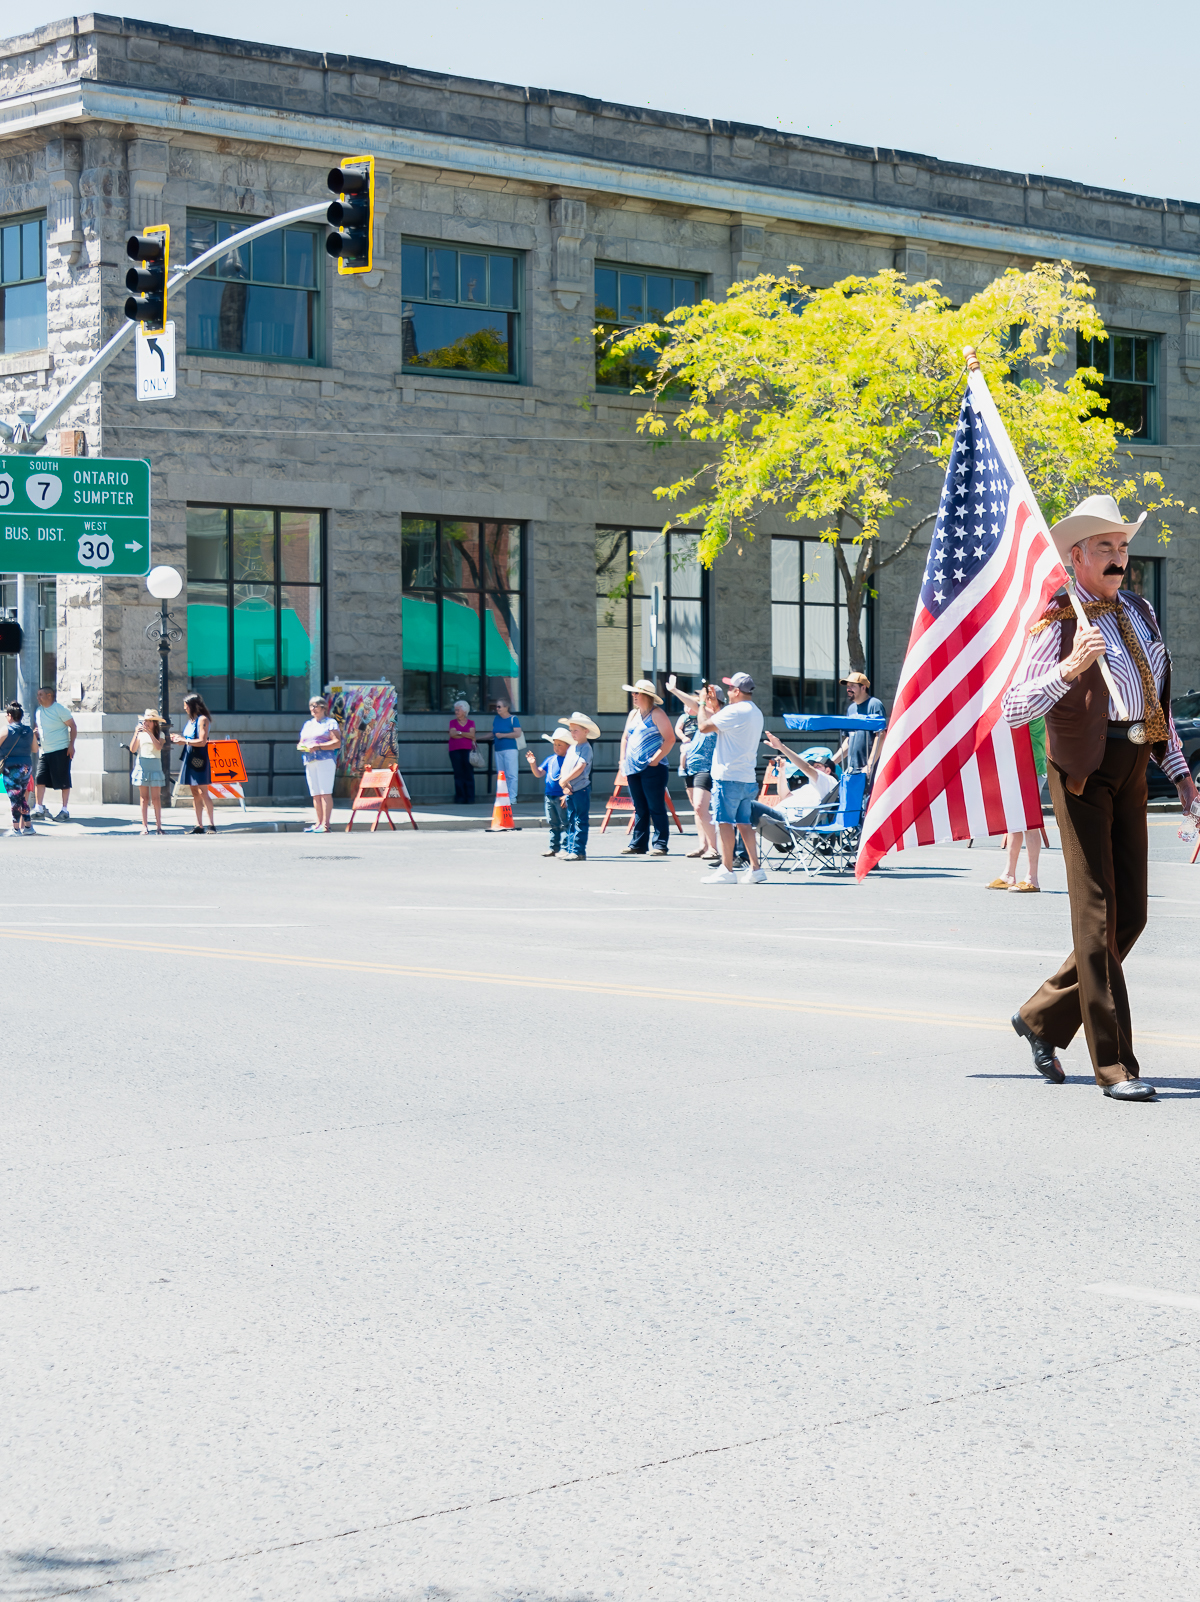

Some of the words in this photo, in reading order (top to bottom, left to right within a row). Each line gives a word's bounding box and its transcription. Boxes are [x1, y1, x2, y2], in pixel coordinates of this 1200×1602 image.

[143, 377, 169, 392] ONLY
[29, 460, 59, 471] SOUTH
[73, 470, 129, 486] ONTARIO
[37, 481, 51, 500] 7
[73, 490, 134, 505] SUMPTER
[84, 521, 107, 531] WEST
[5, 526, 31, 541] BUS.
[38, 527, 66, 542] DIST.
[82, 541, 110, 560] 30
[210, 758, 239, 768] TOUR
